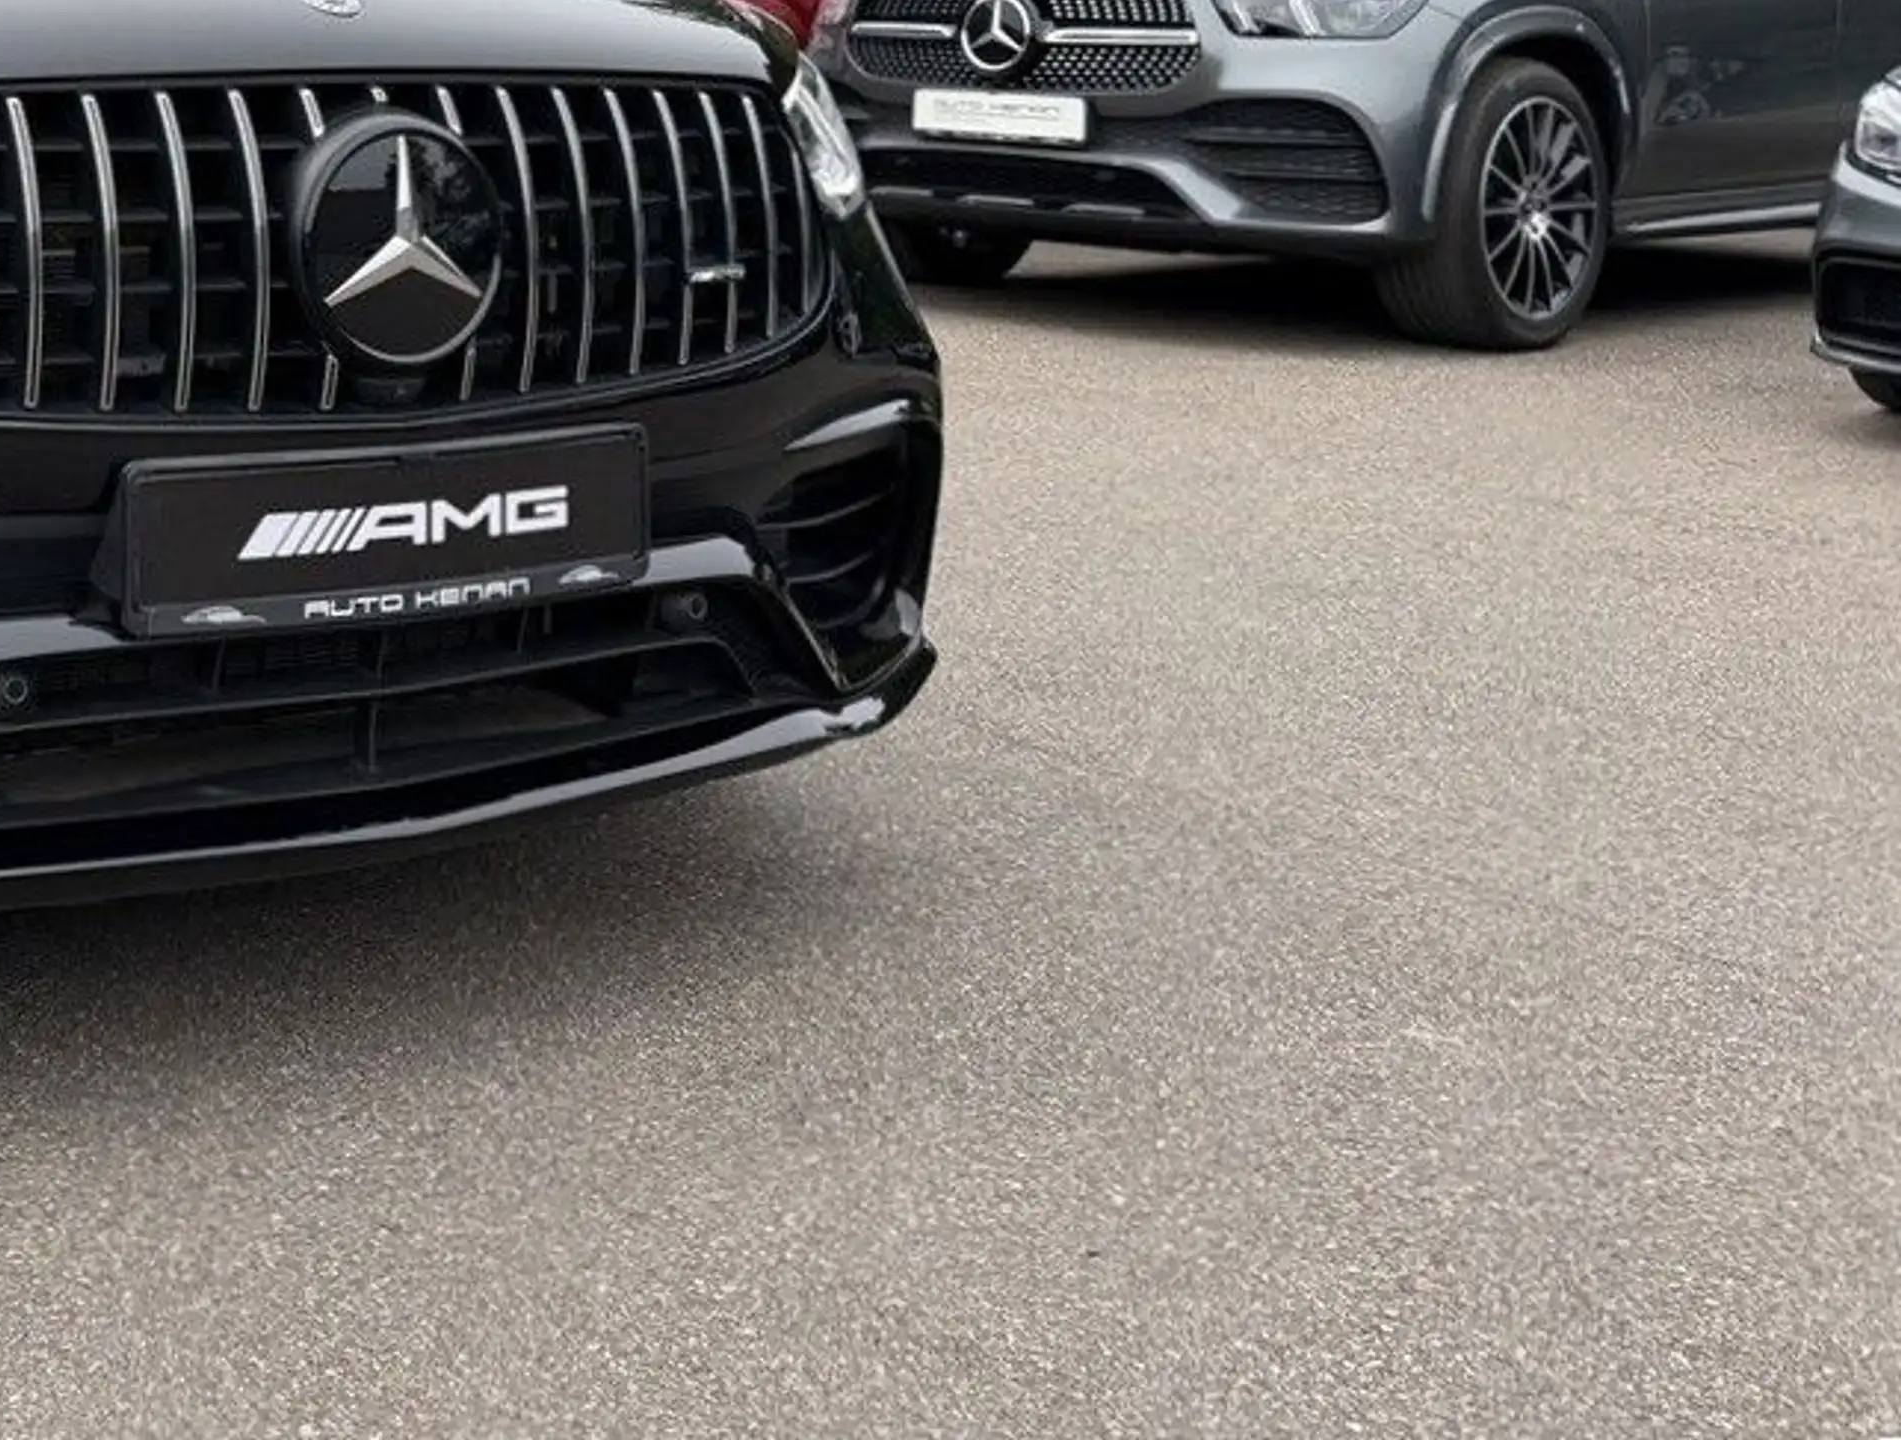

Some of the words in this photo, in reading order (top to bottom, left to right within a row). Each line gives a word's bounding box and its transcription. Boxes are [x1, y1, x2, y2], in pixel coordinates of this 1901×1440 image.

[346, 484, 569, 552] AMG
[304, 593, 405, 620] AUTO
[415, 577, 531, 610] KENAN
